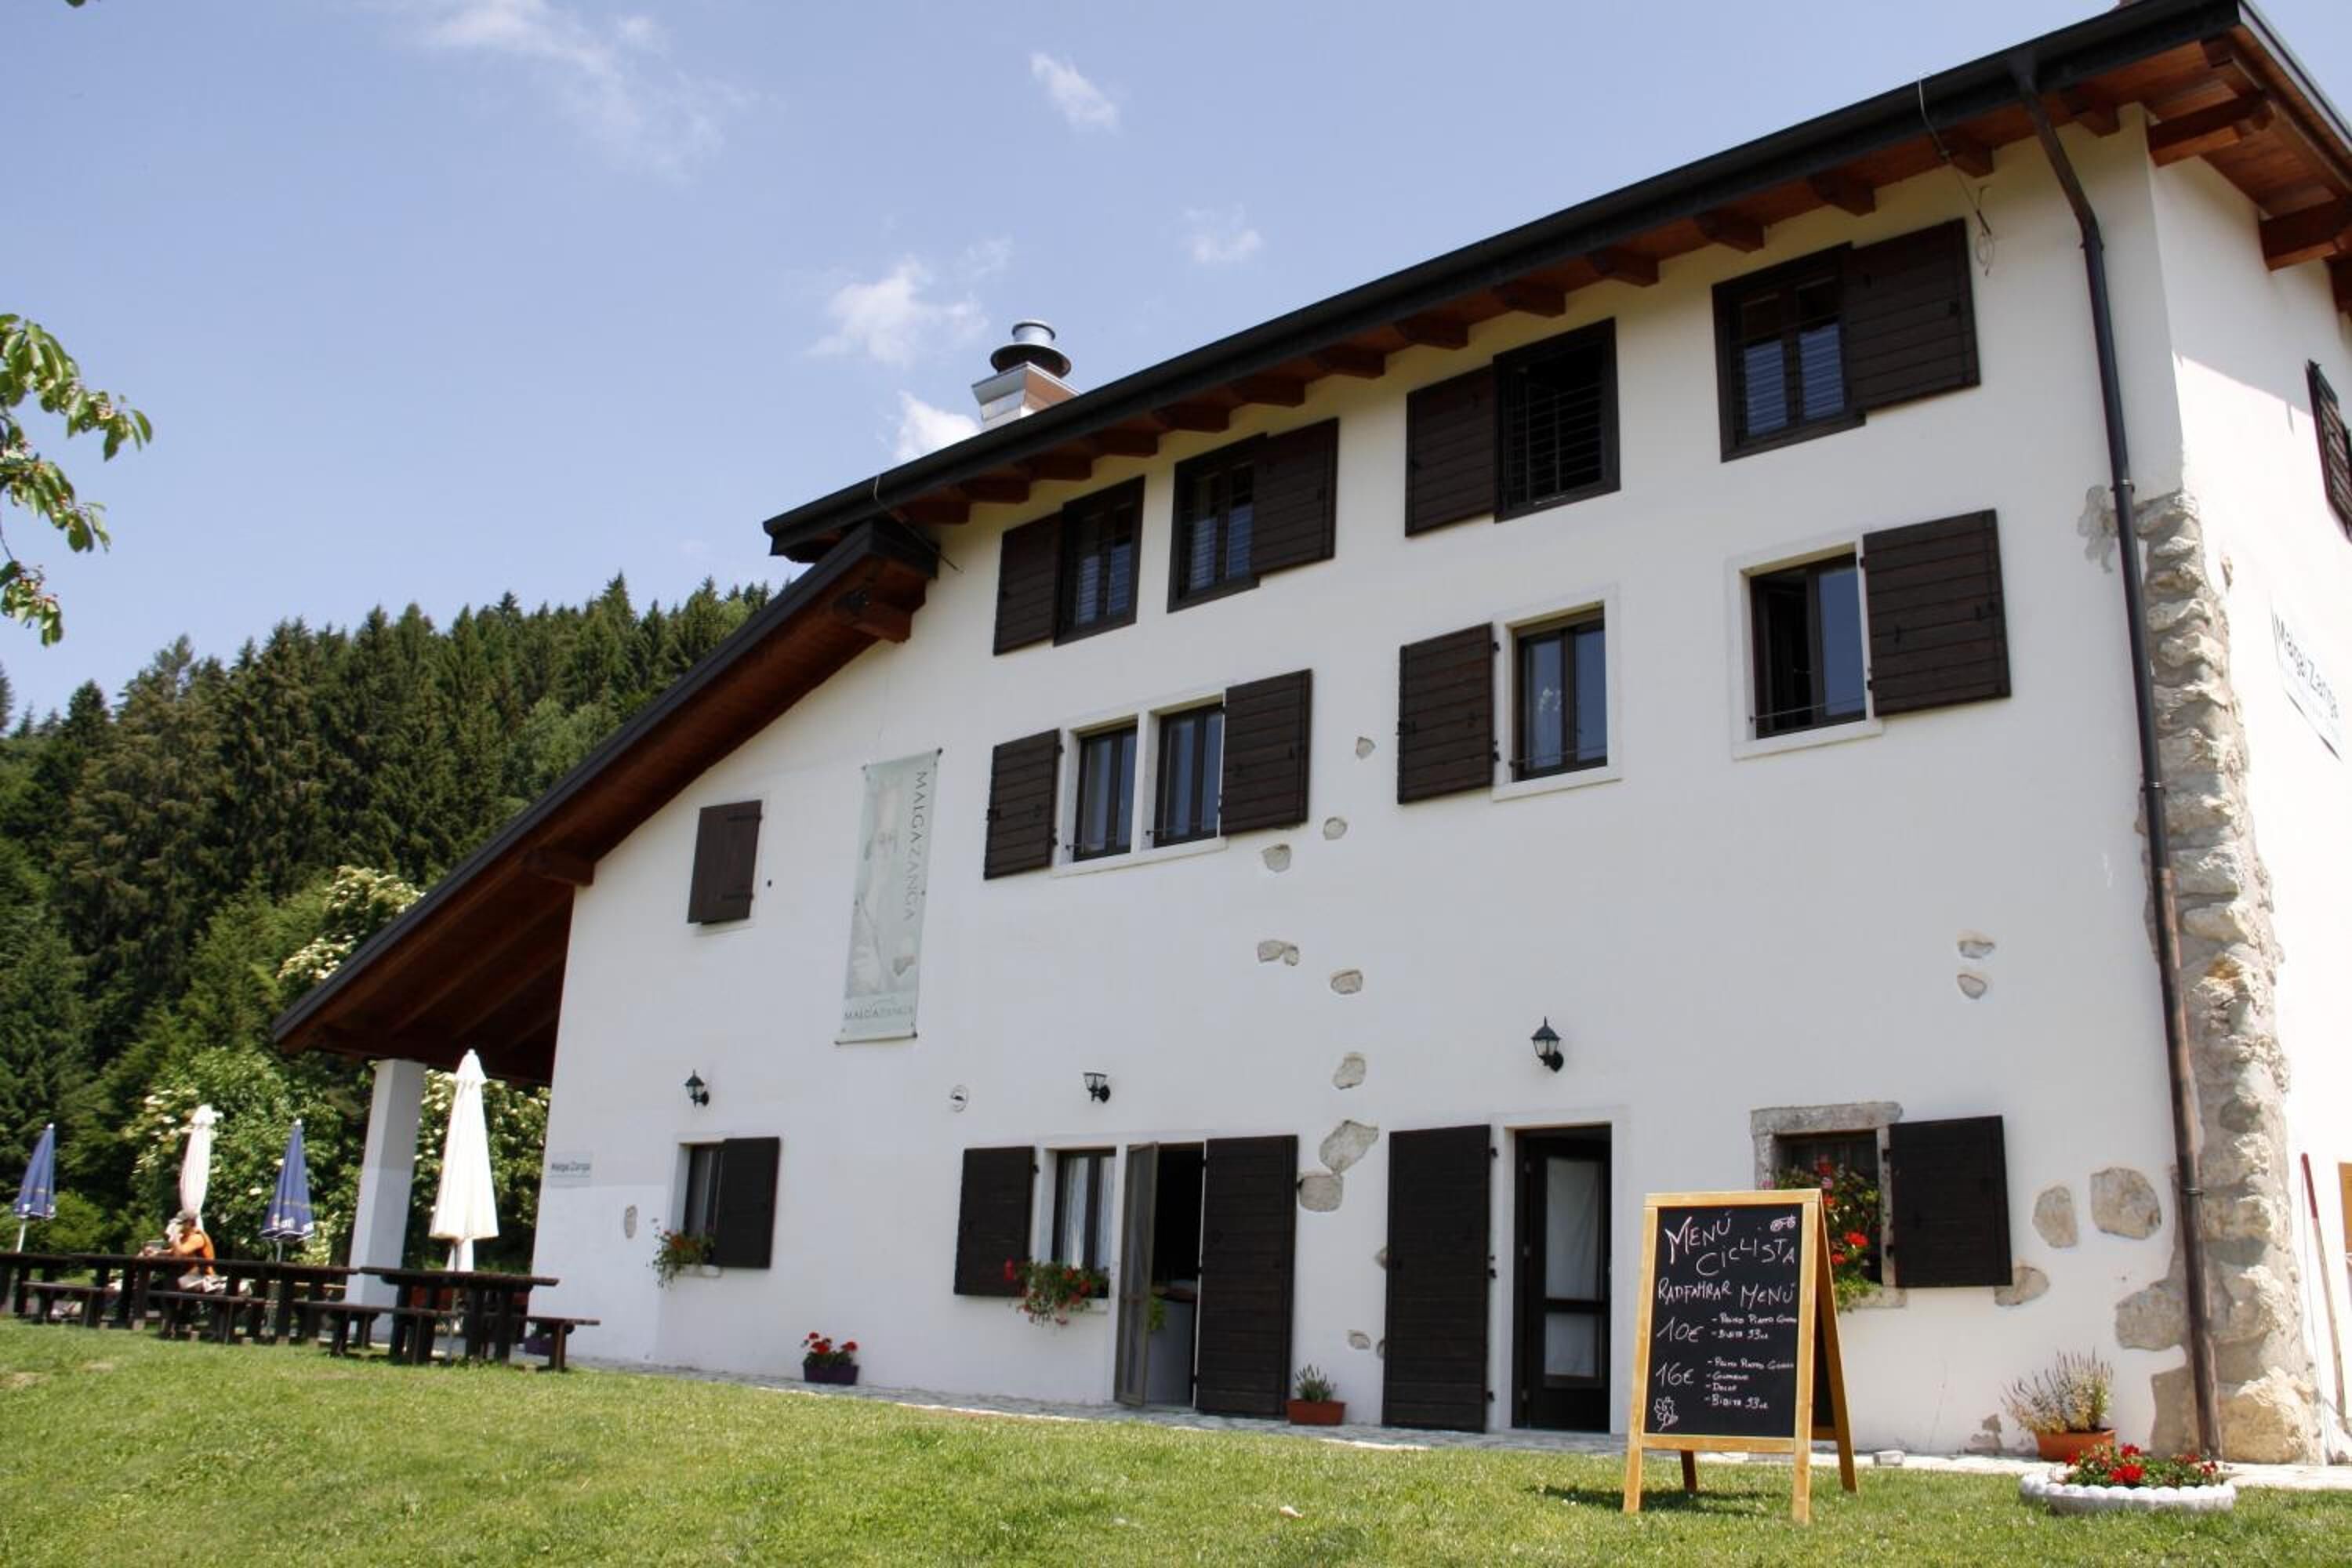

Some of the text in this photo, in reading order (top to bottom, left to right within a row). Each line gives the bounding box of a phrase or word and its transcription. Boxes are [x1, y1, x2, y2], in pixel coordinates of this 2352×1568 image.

[1696, 1238, 1795, 1276] CICLISTA
[1657, 1316, 1704, 1342] 10€
[1655, 1362, 1694, 1388] 16€
